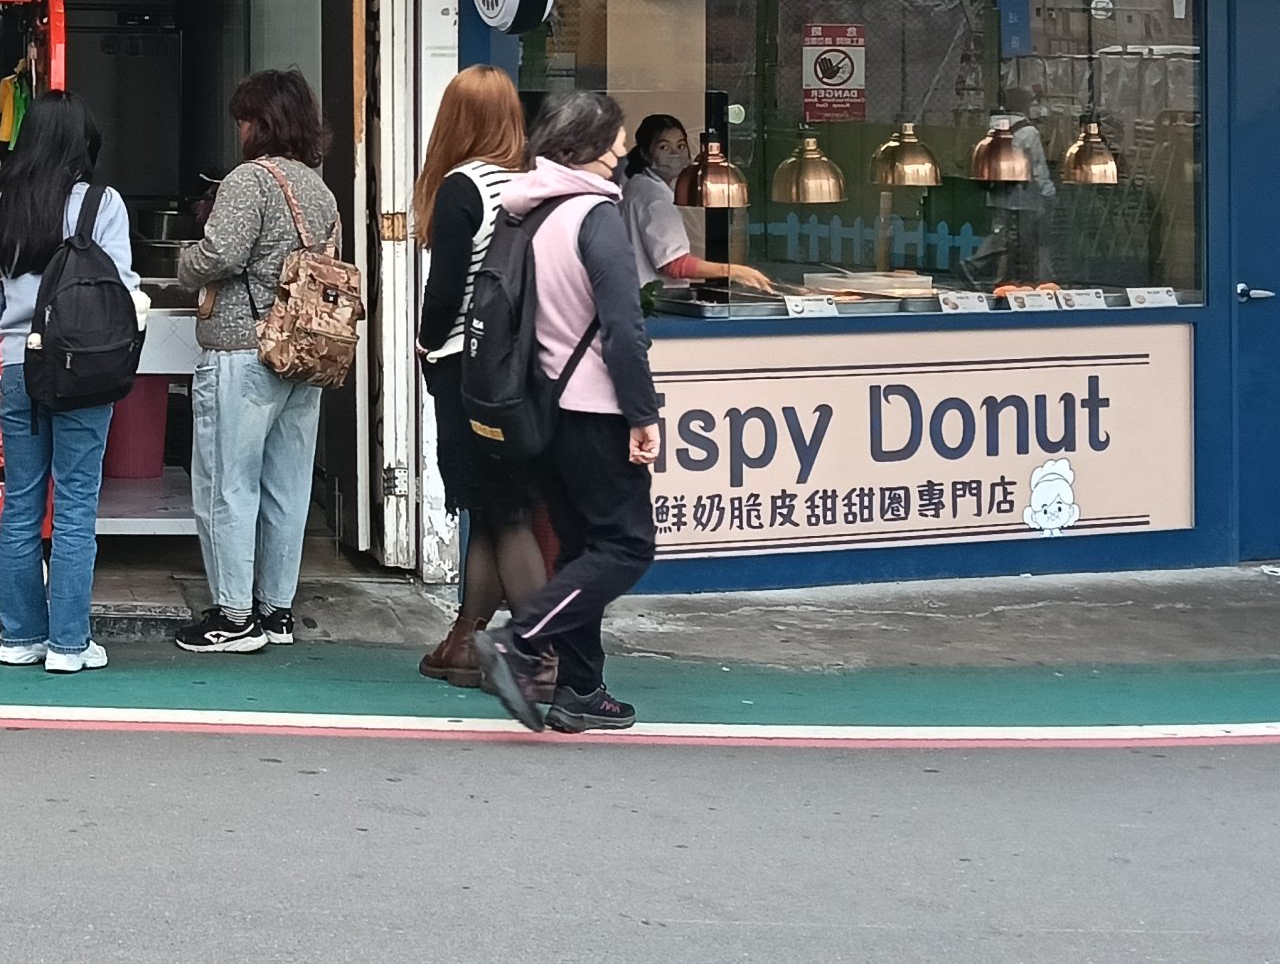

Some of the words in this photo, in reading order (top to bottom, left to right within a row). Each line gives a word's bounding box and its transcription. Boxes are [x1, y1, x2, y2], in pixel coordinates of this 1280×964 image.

[867, 374, 1111, 464] Donut
[654, 474, 1018, 535] 鮮奶脆皮甜甜圈專門店
